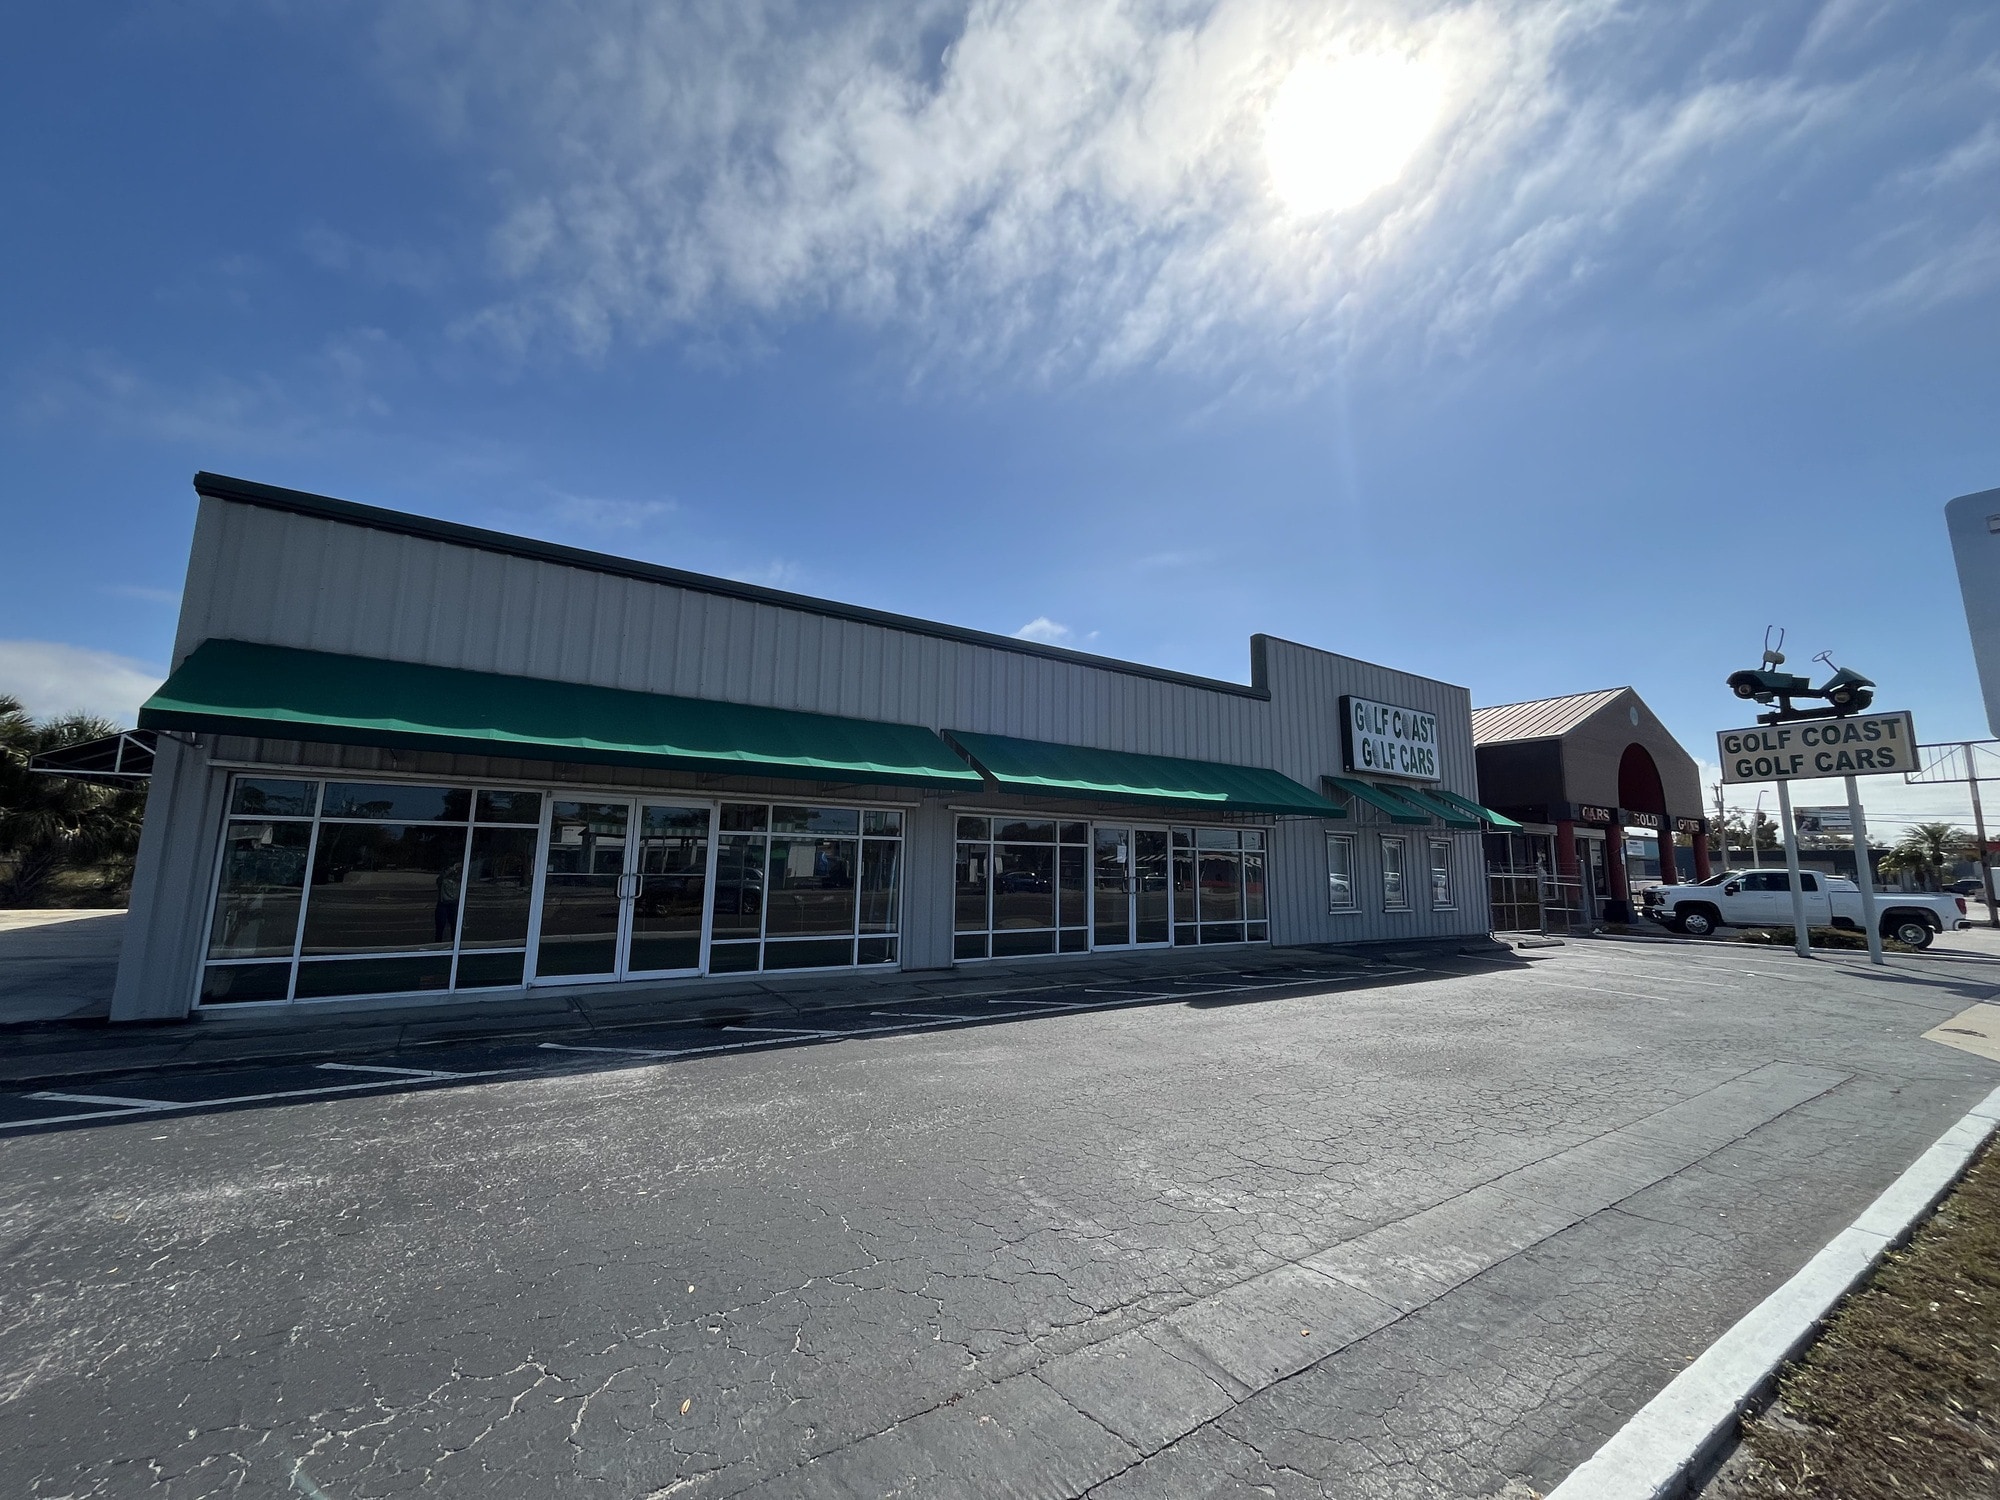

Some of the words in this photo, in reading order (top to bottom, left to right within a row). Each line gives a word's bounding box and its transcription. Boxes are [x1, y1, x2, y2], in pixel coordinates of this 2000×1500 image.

[1355, 702, 1389, 736] GOLF
[1393, 711, 1435, 744] COAST
[1724, 730, 1791, 754] GOLF
[1802, 718, 1900, 748] COAST
[1362, 737, 1396, 771] GOLF
[1400, 744, 1435, 776] CARS
[1736, 754, 1804, 778] GOLF
[1815, 747, 1896, 773] CARS
[1582, 806, 1610, 821] CARS
